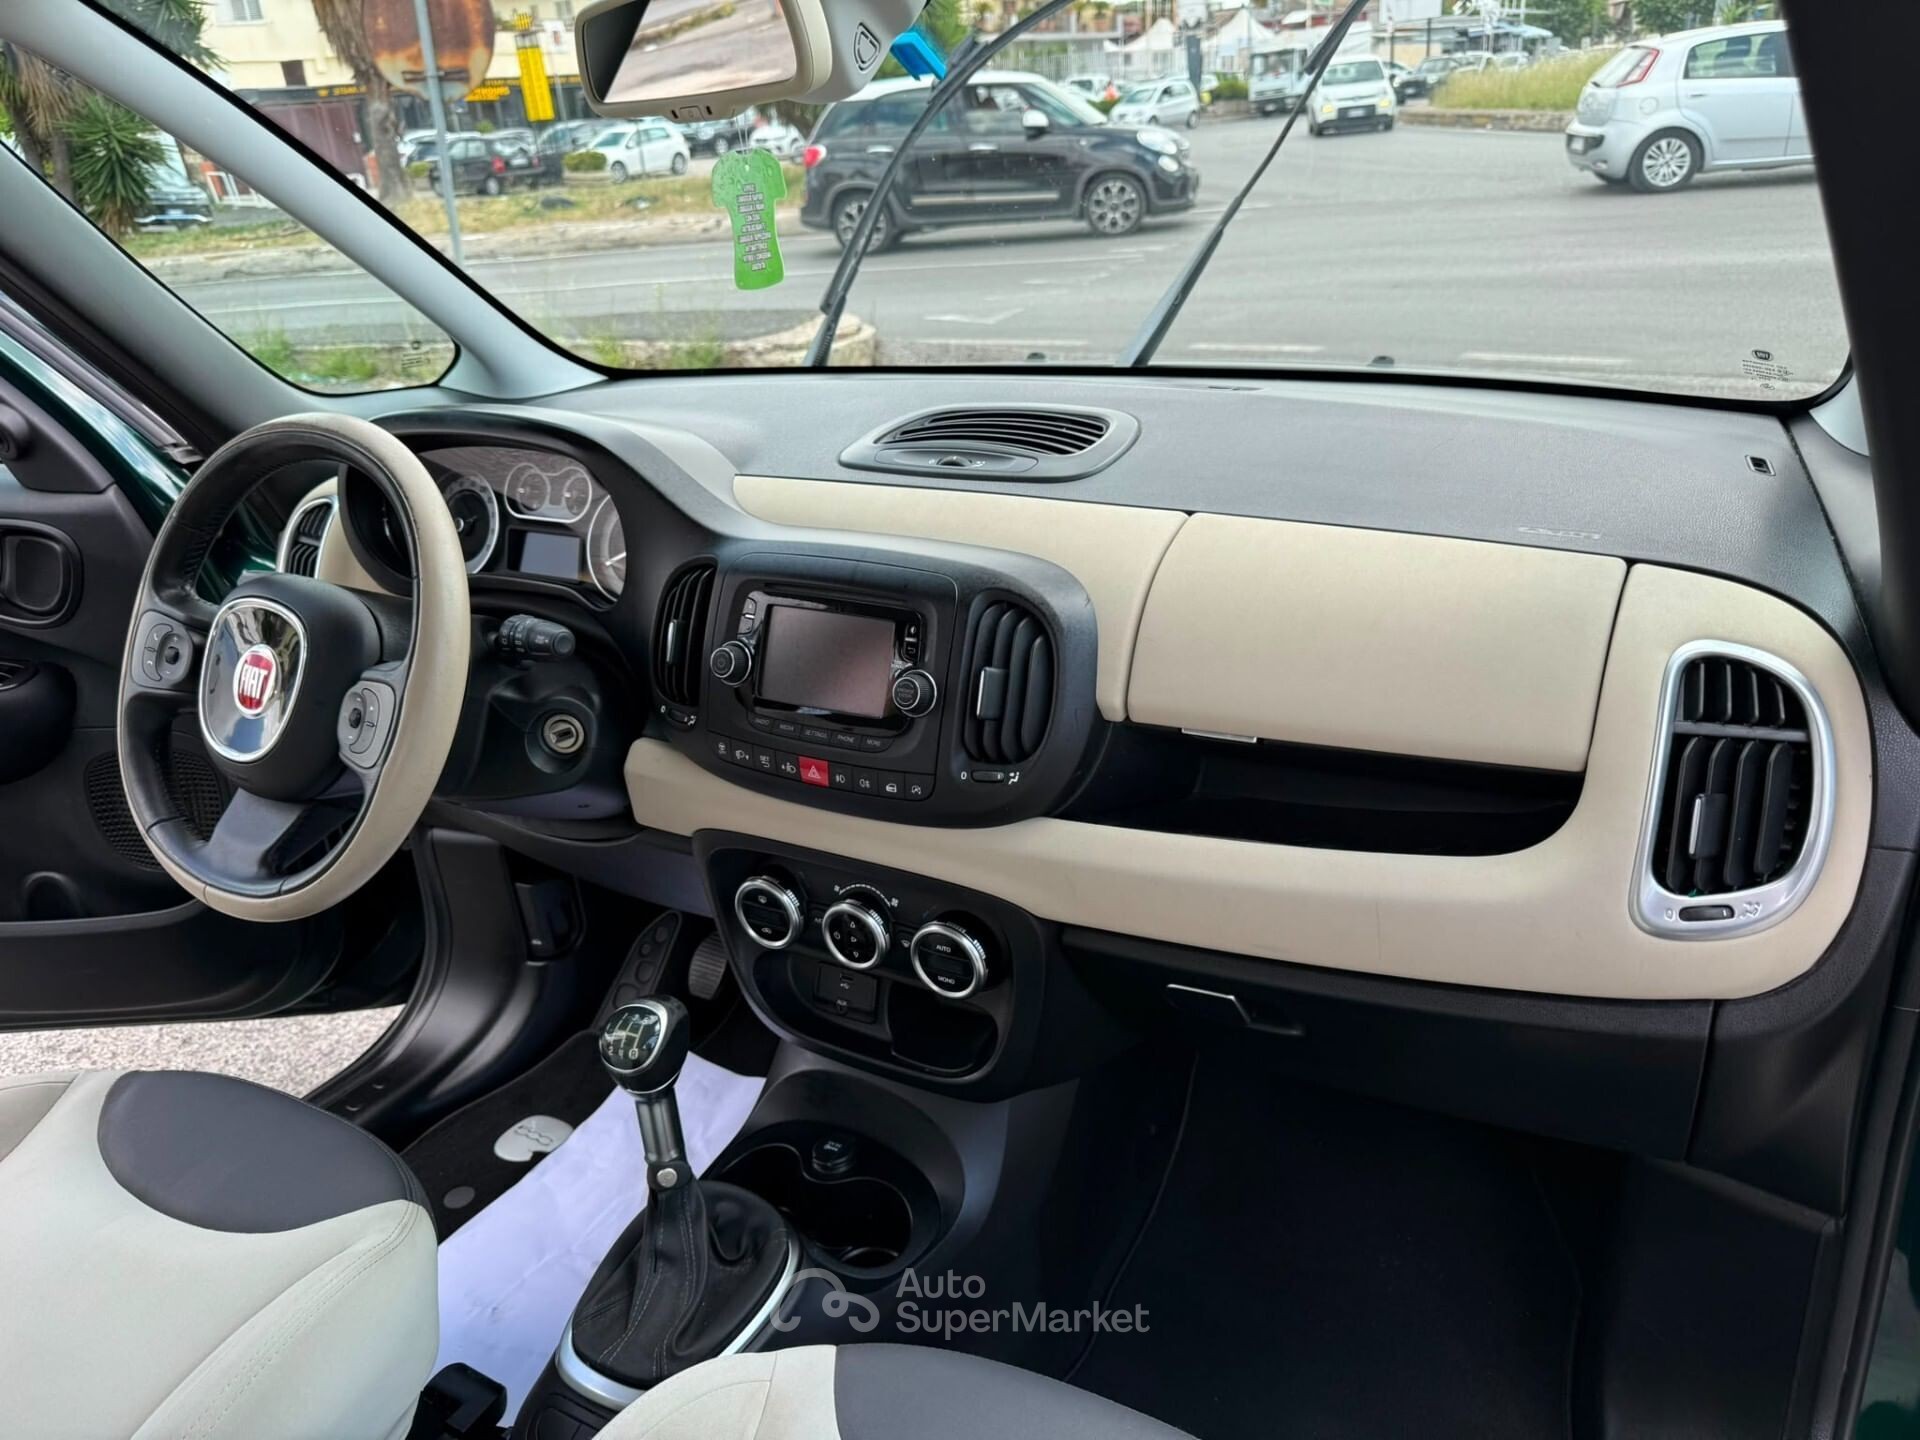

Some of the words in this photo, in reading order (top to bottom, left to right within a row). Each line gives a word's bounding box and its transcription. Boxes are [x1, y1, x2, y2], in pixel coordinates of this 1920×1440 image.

[240, 663, 269, 699] FIAT
[837, 734, 855, 743] PHONE
[936, 945, 951, 953] AUTO
[938, 976, 955, 984] MONO
